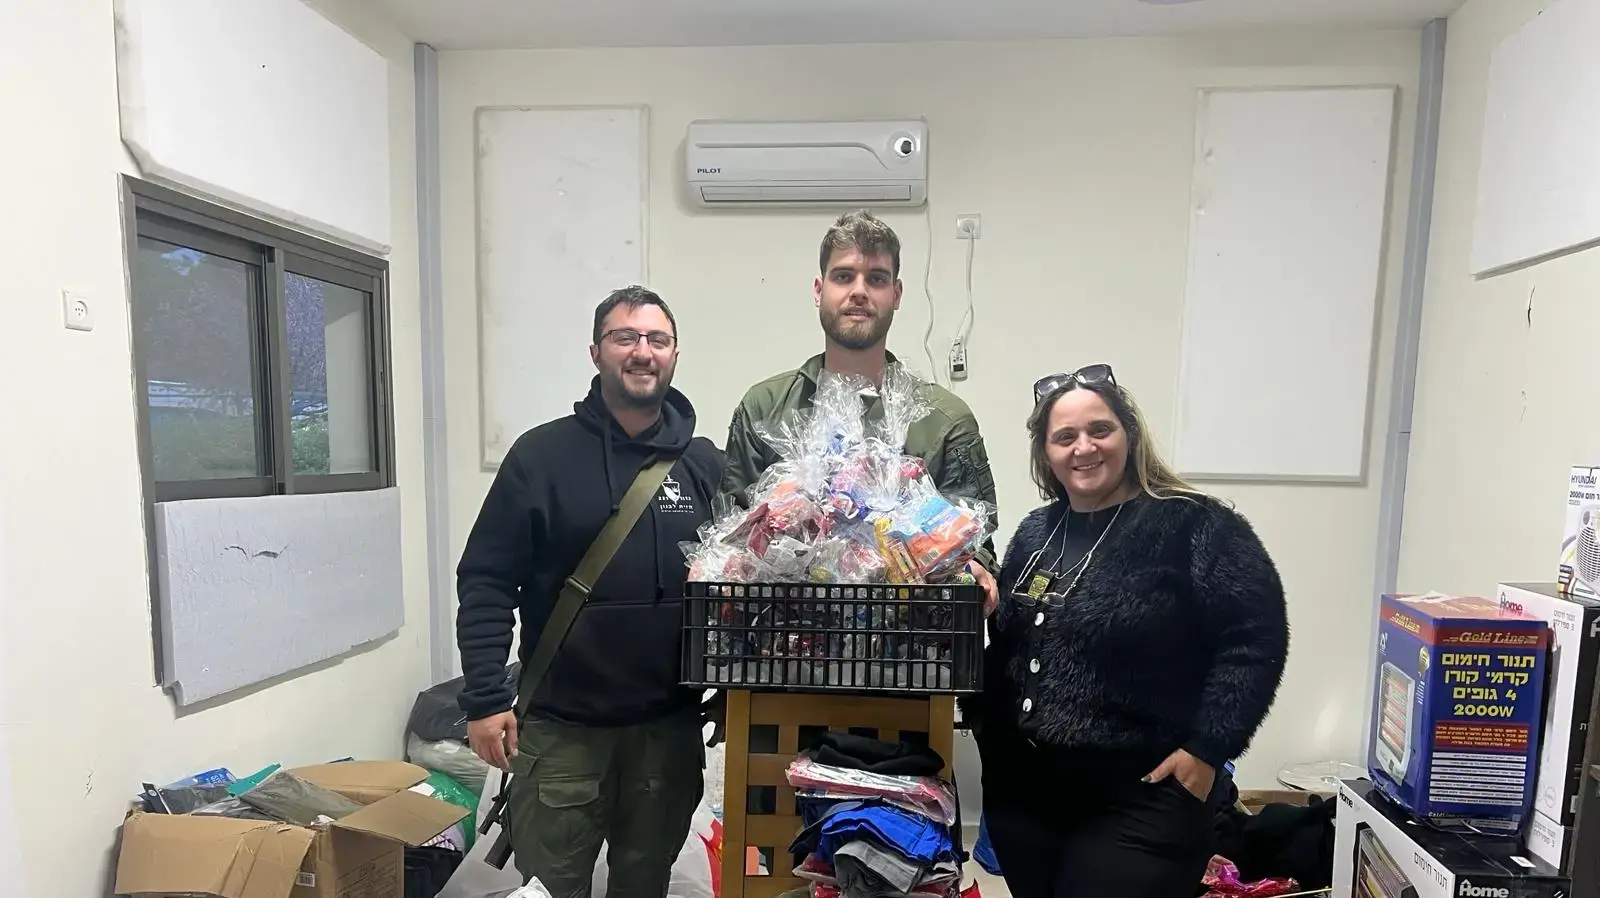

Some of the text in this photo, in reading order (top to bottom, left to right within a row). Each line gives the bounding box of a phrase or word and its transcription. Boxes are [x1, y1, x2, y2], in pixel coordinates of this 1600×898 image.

[1571, 475, 1598, 485] HYUNDAI
[1460, 632, 1493, 643] Gold
[1441, 653, 1491, 666] חימום
[1497, 655, 1535, 668] תנור
[1445, 670, 1529, 686] קרמי קורן
[1453, 687, 1517, 701] 4 גופים
[1453, 703, 1514, 717] 2000W
[1413, 851, 1449, 890] תנור חימום
[1459, 879, 1510, 898] Home
